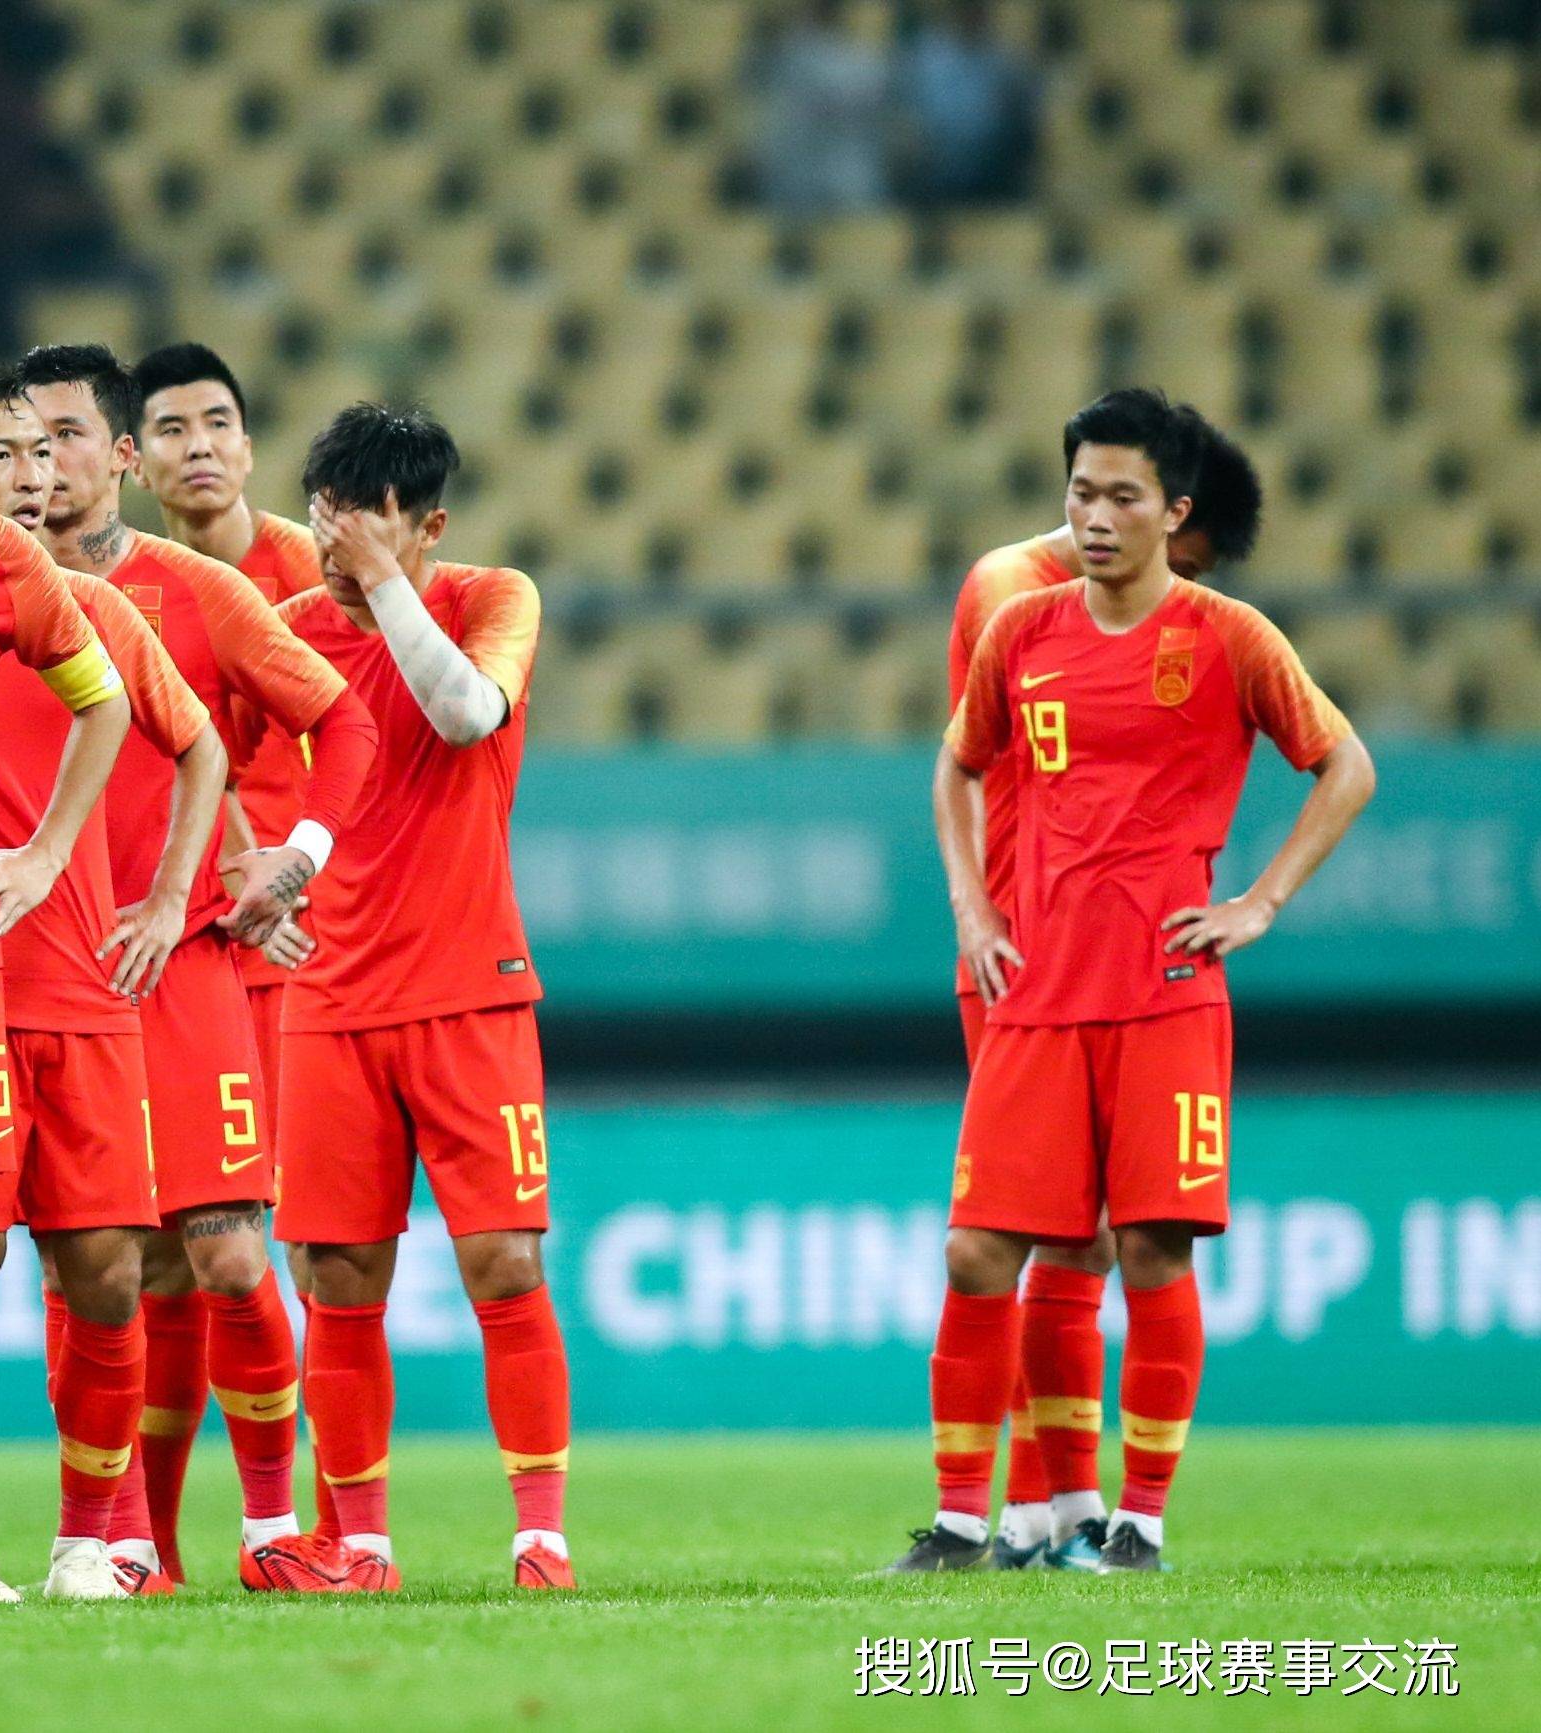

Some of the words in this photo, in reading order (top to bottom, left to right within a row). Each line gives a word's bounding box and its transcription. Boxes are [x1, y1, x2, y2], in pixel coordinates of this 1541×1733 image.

[1020, 701, 1068, 772] 19
[219, 1073, 257, 1145] 5
[500, 1103, 547, 1175] 13
[1175, 1092, 1224, 1166] 19
[582, 1197, 960, 1350] CHIN
[1094, 1197, 1373, 1345] UP
